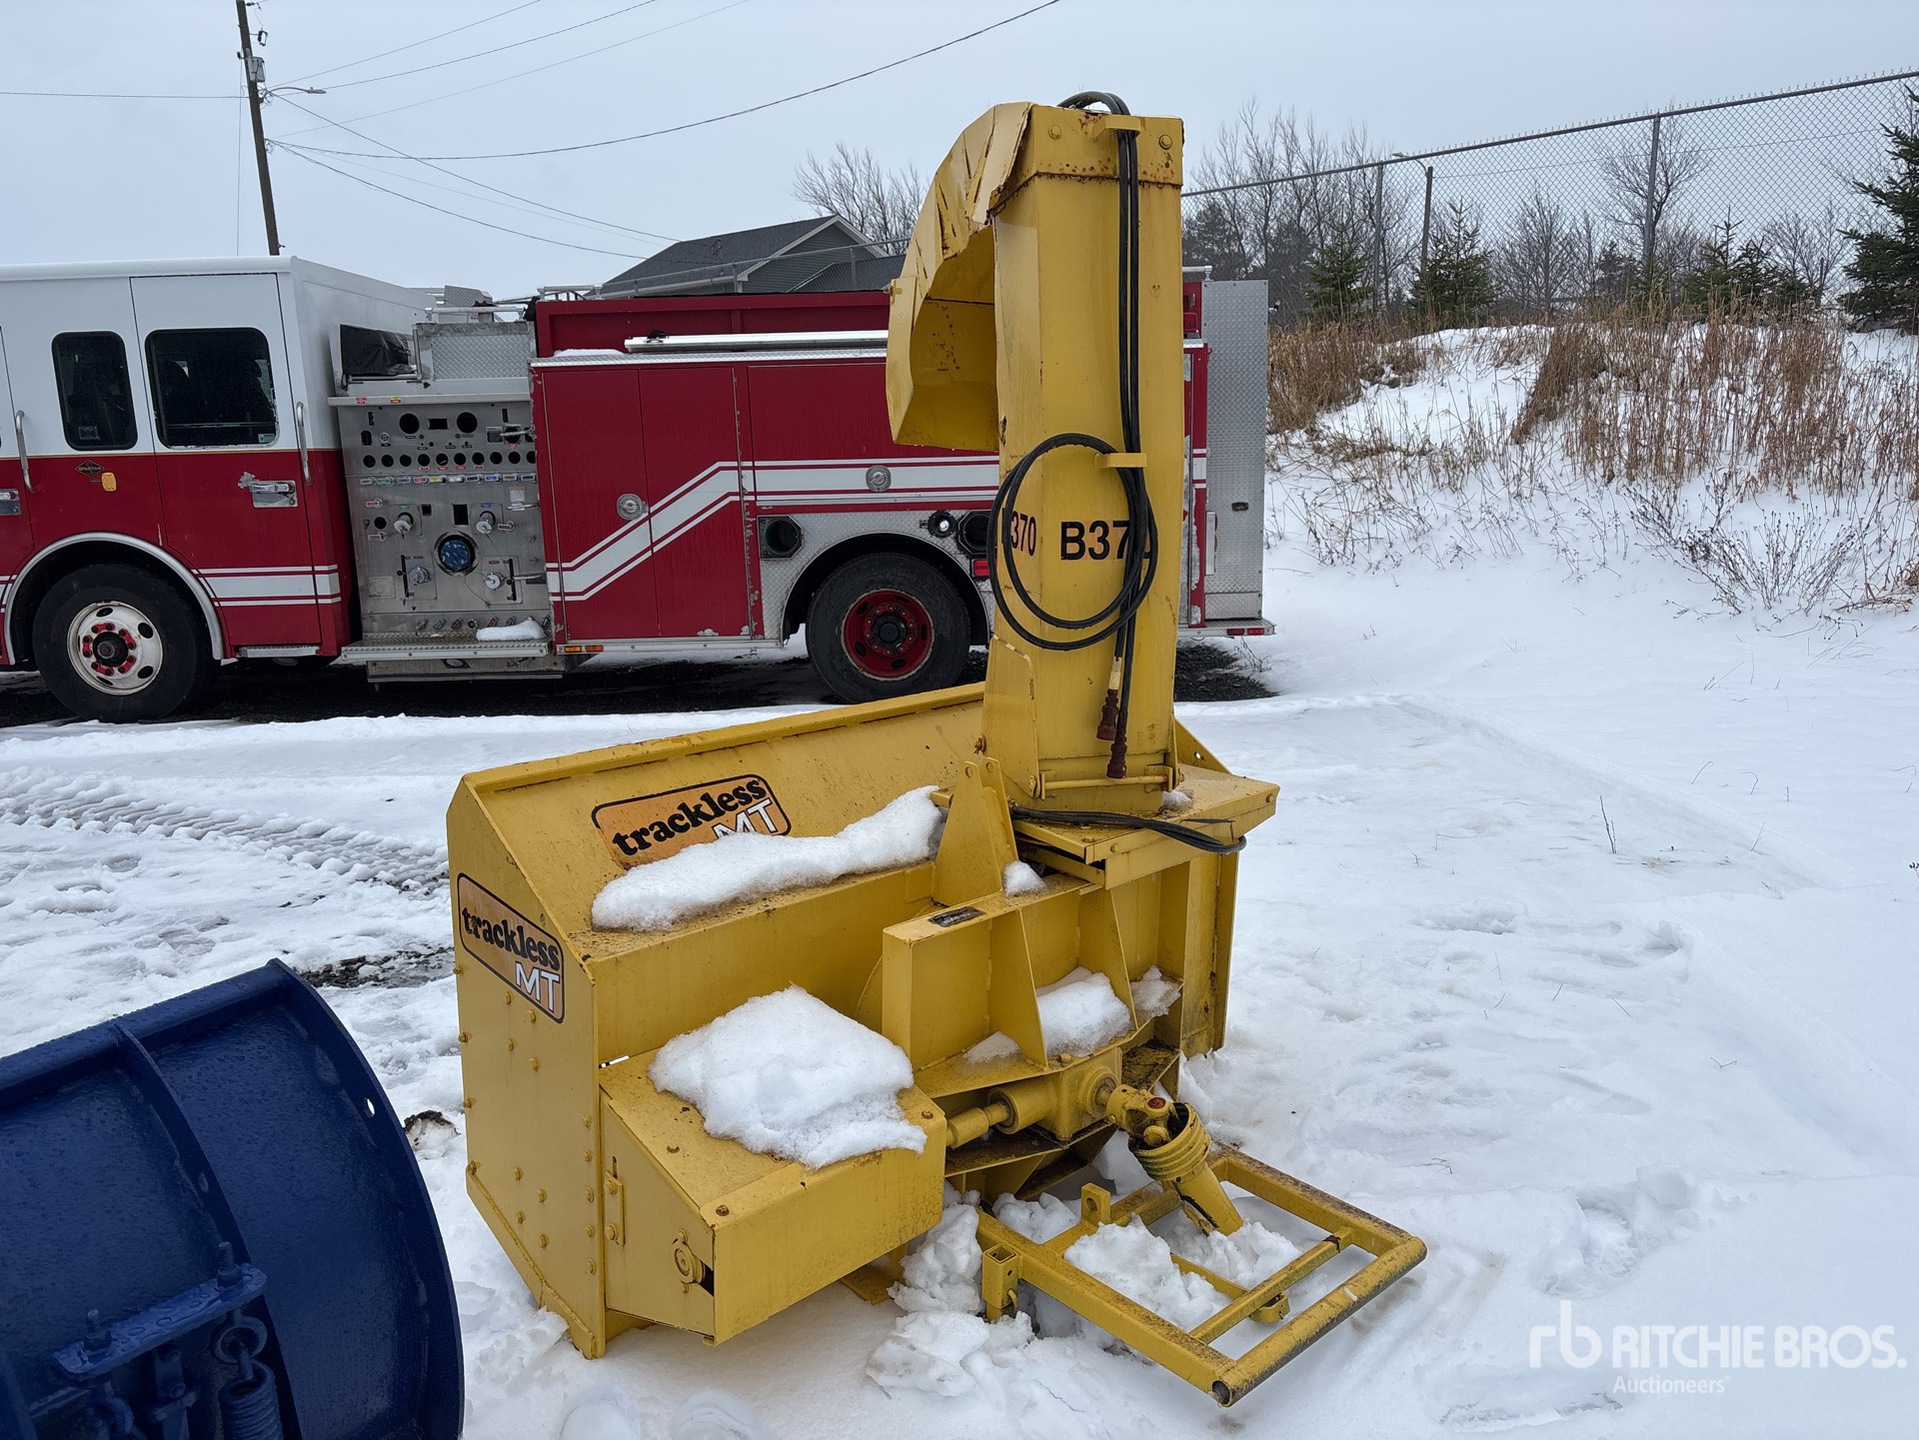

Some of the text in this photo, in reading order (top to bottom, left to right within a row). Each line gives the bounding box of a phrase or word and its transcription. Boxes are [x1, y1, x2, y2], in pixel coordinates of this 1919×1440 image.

[1002, 508, 1036, 556] 370
[1060, 520, 1151, 560] B37
[612, 779, 767, 855] trackless
[711, 797, 778, 839] MT
[462, 907, 560, 971] trackless
[515, 961, 560, 1013] MT
